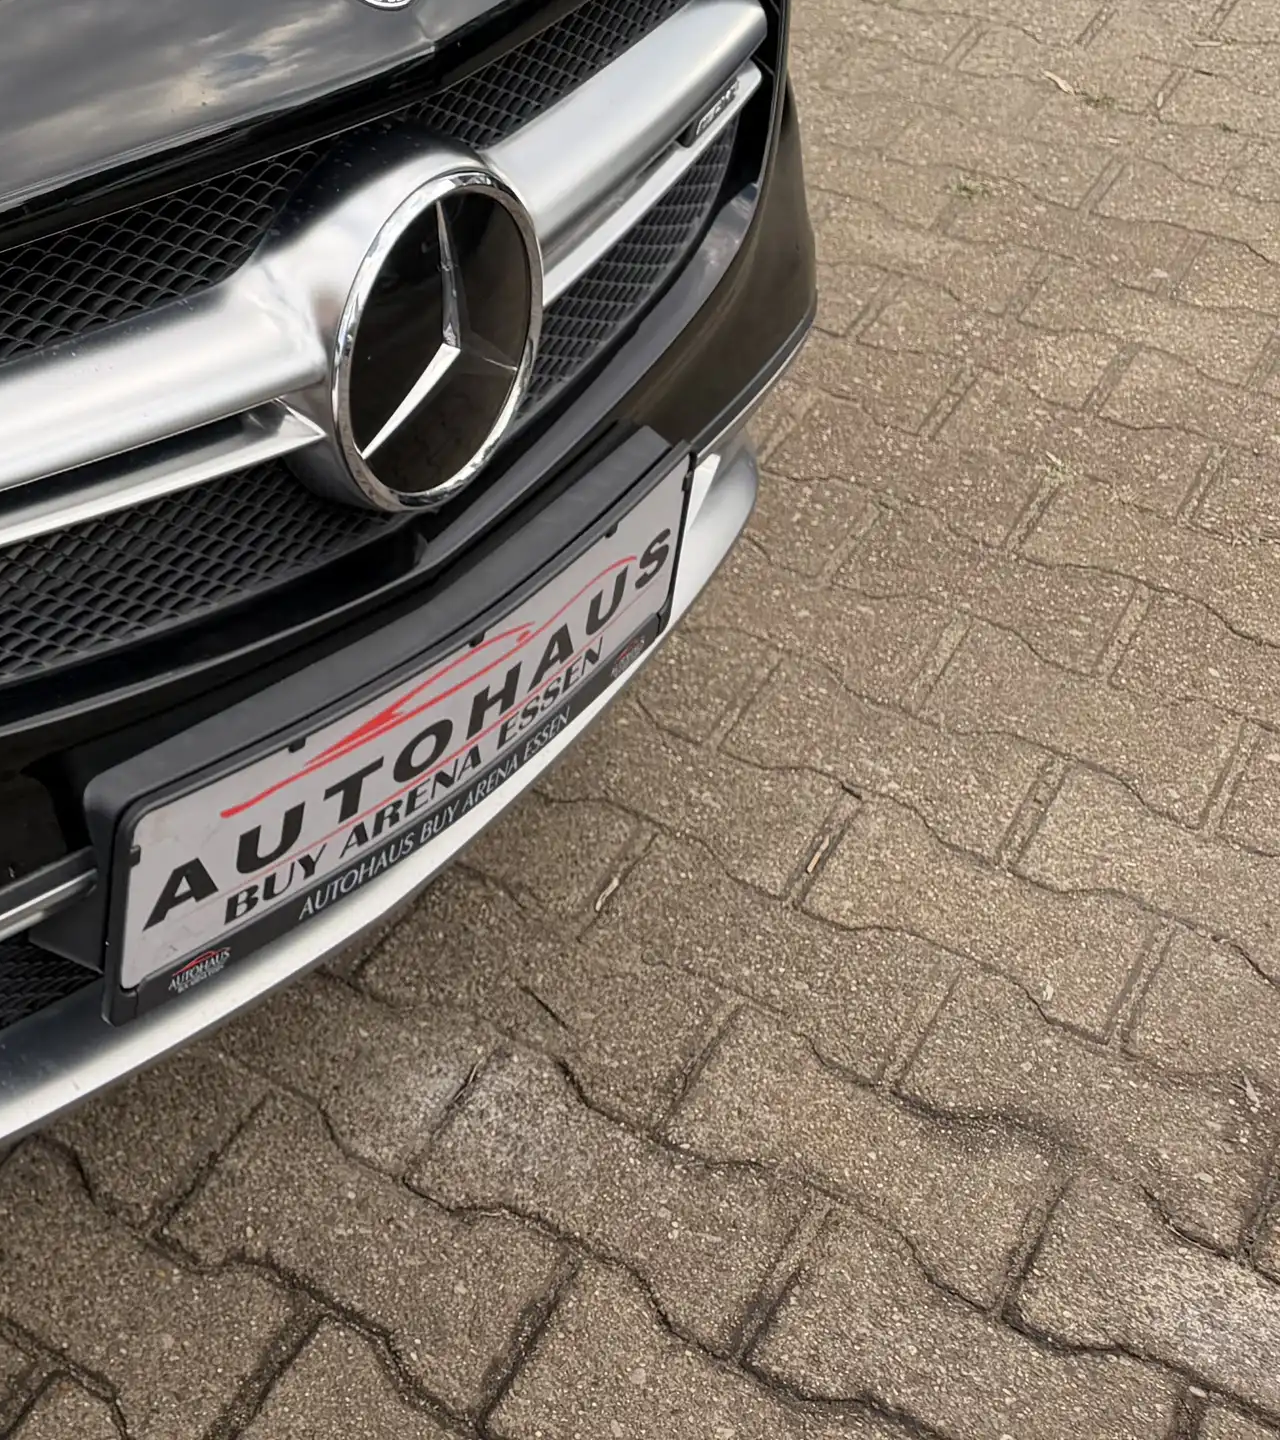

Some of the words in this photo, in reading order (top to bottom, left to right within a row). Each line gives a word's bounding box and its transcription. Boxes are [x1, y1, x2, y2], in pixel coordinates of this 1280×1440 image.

[142, 528, 671, 932] AUTOHAUS
[224, 844, 328, 926] BUY
[339, 744, 483, 859] ARENA
[496, 636, 603, 751] ESSEN
[298, 831, 416, 921] AUTOHAUS
[420, 803, 461, 841] BUY
[461, 755, 519, 814] ARENA
[524, 705, 571, 759] ESSEN
[168, 950, 231, 992] AUTOHAUS
